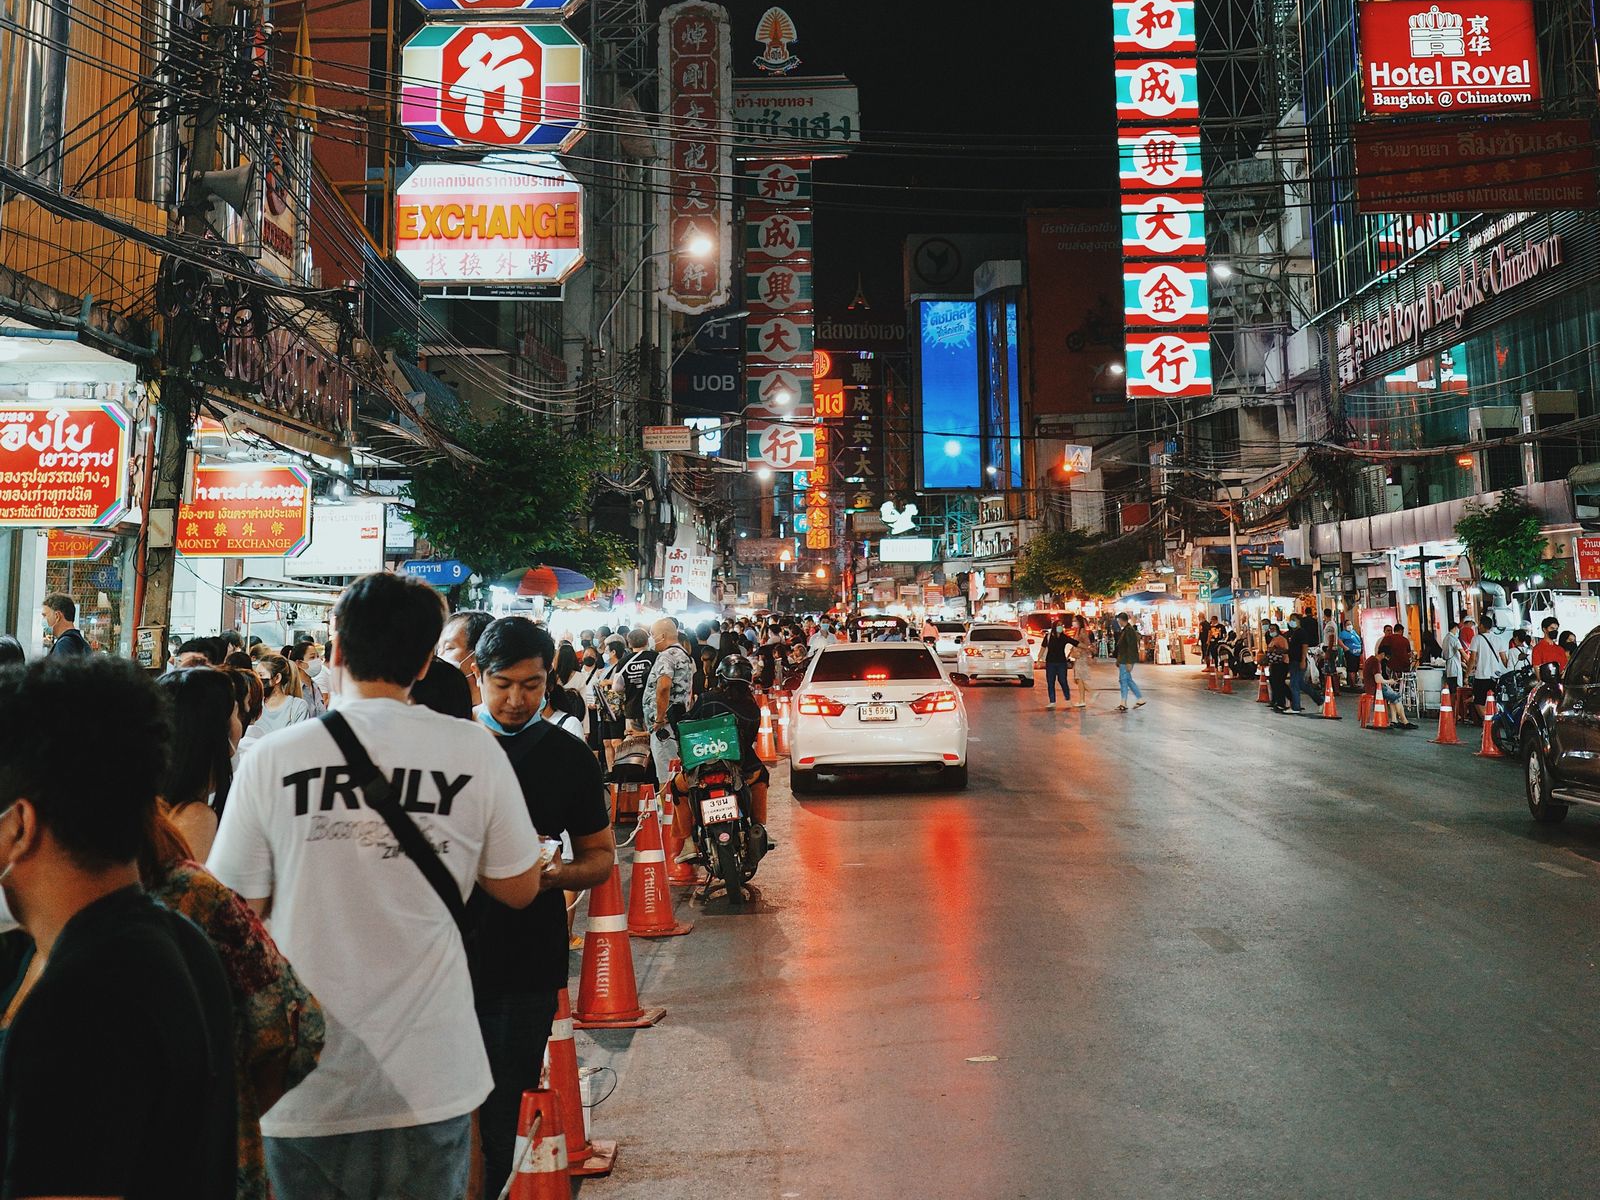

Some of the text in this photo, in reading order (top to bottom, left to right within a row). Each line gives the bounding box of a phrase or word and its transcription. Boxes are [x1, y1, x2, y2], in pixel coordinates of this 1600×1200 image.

[1370, 59, 1530, 87] Hotel Royal
[1373, 91, 1532, 108] Bangkok @ Chinatown
[1136, 1, 1187, 387] 和成興大金行
[1430, 190, 1465, 203] HENG
[1466, 188, 1522, 203] NATURAL
[1523, 186, 1584, 201] MEDICINE
[398, 202, 577, 240] EXCHANGE
[1361, 305, 1395, 359] Hotel
[1394, 283, 1435, 346] Royal
[1433, 259, 1485, 329] Bangkok
[1490, 234, 1564, 296] Chinatown
[693, 374, 736, 392] UOB
[39, 448, 114, 468] เยาวราช
[218, 506, 302, 520] เงินตราต่างประเทศ
[177, 539, 291, 549] MONEY EXCHANGE
[407, 564, 462, 578] เยาวราช 9
[693, 737, 728, 757] Grab
[709, 812, 734, 824] 8644
